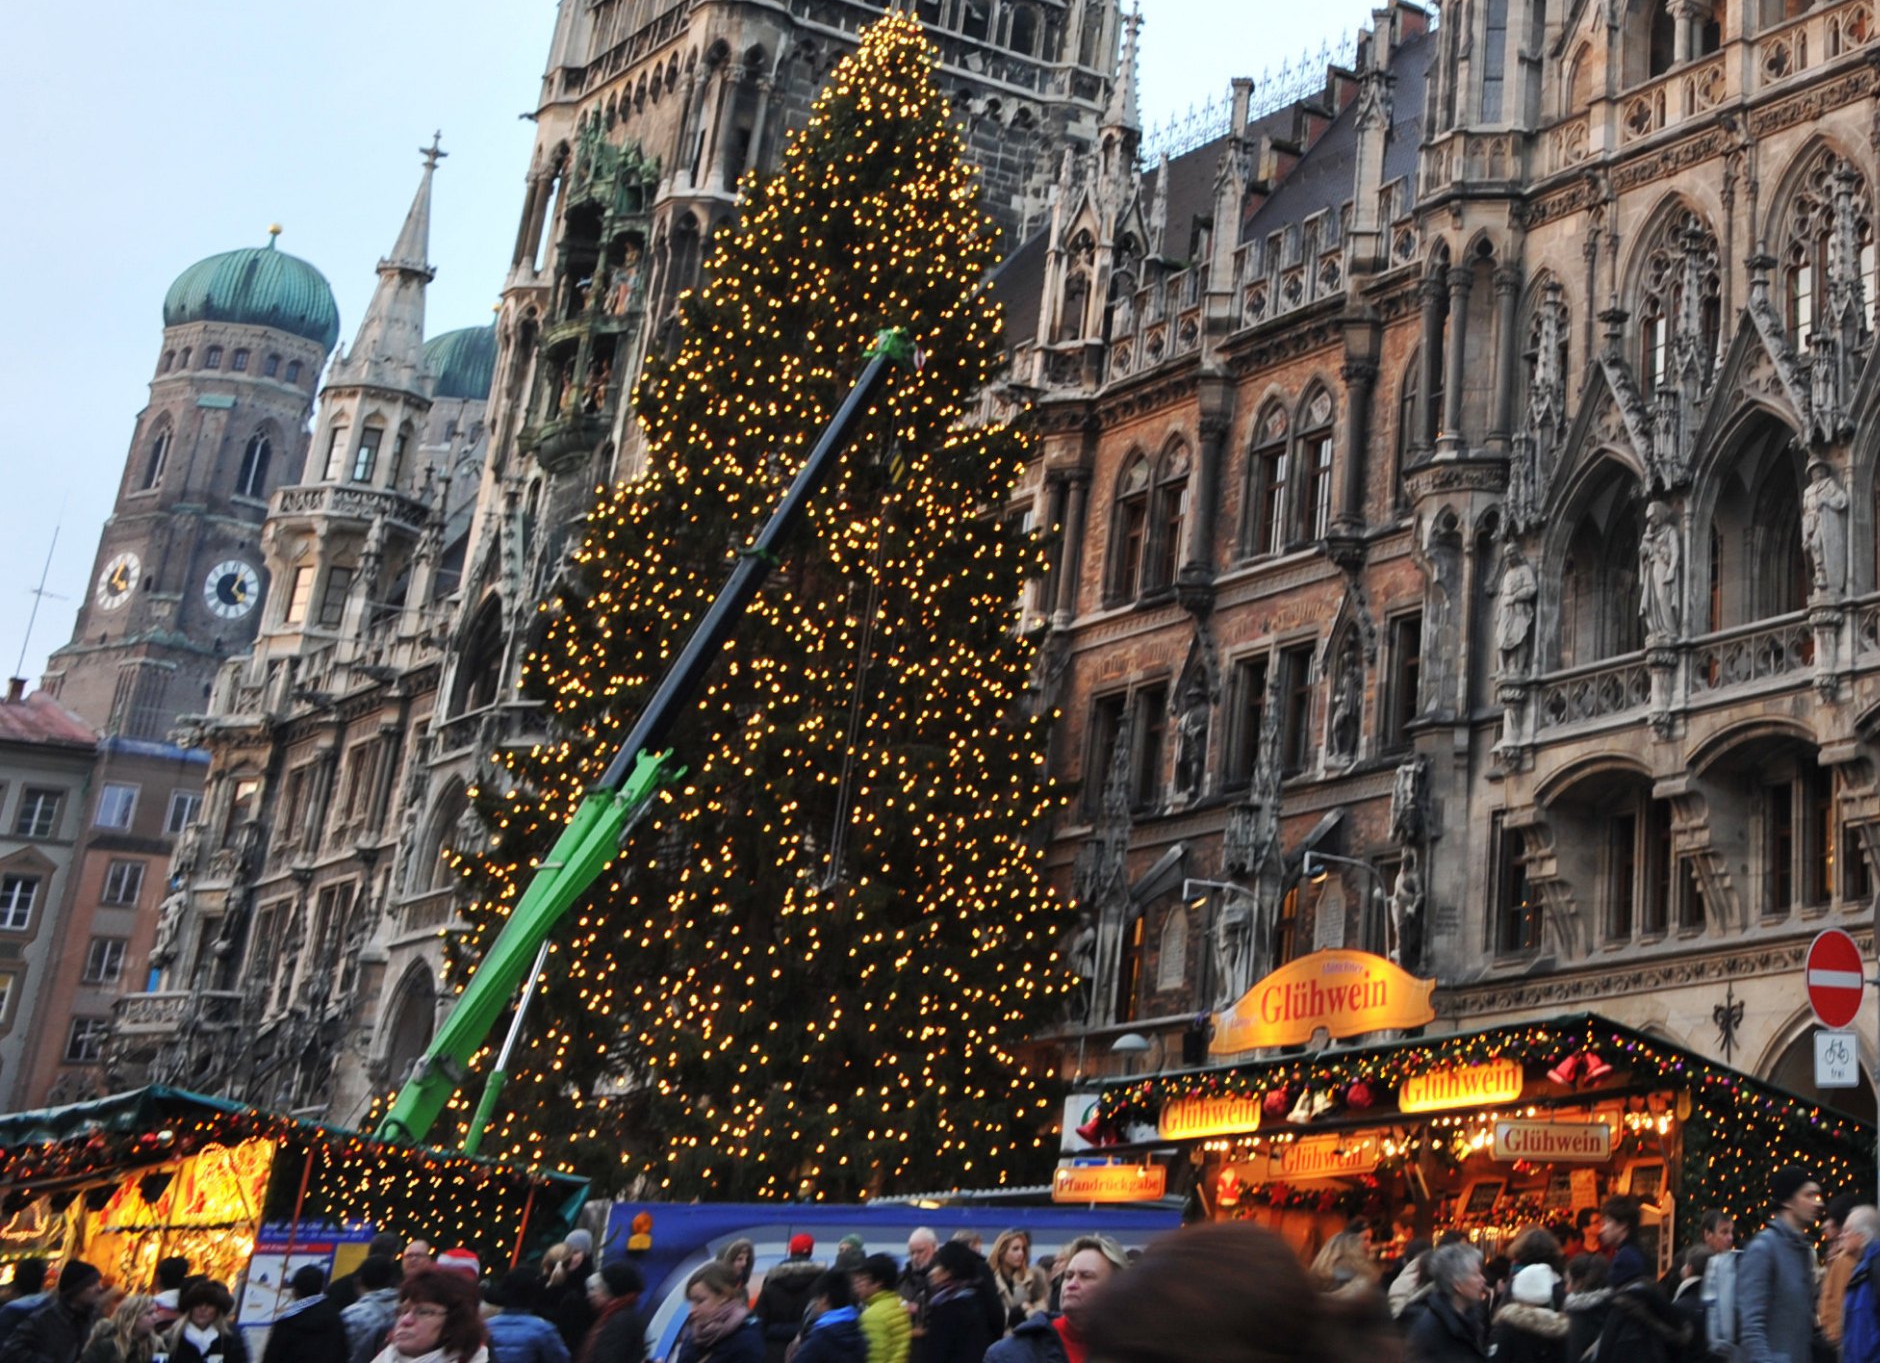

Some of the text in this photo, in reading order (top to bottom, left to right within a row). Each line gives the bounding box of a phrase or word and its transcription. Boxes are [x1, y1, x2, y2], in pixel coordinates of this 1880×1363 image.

[1260, 970, 1388, 1024] Glühwein
[1503, 1128, 1601, 1153] Glühwein
[1059, 1178, 1159, 1194] Pfandrückgabe
